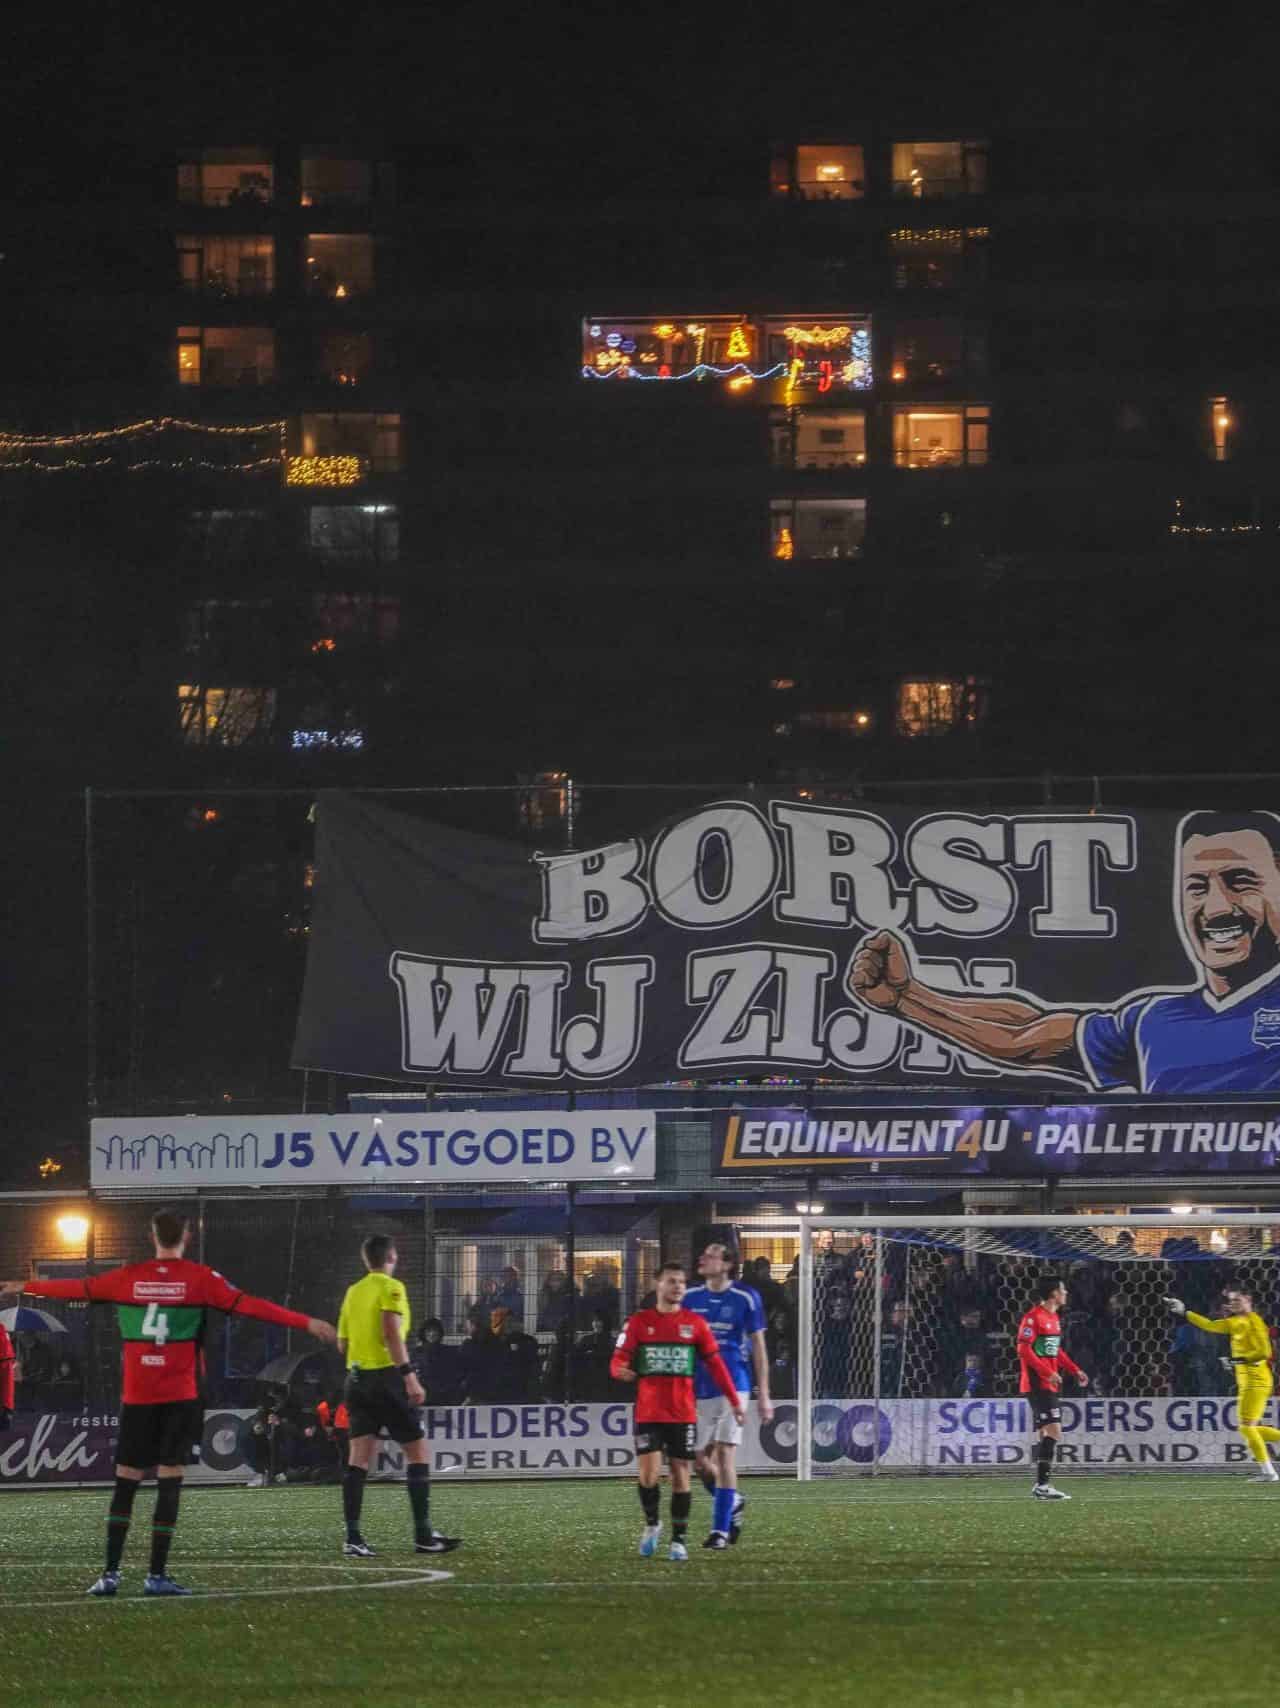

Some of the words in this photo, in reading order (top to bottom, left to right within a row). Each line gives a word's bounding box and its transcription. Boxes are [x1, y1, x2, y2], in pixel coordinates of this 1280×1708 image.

[530, 799, 1137, 943] BORST
[391, 950, 653, 1079] WIJ
[262, 1131, 314, 1168] J5
[328, 1127, 574, 1167] VASTGOED
[591, 1126, 648, 1162] BV
[740, 1118, 1010, 1159] EQUIPMENT4U
[142, 1302, 170, 1346] 4
[72, 1408, 120, 1427] resta
[426, 1405, 590, 1440] HILDERS
[939, 1401, 1163, 1433] SCHIDERS
[378, 1449, 634, 1471] NDERLAND
[940, 1444, 1199, 1464] NEDRLAND
